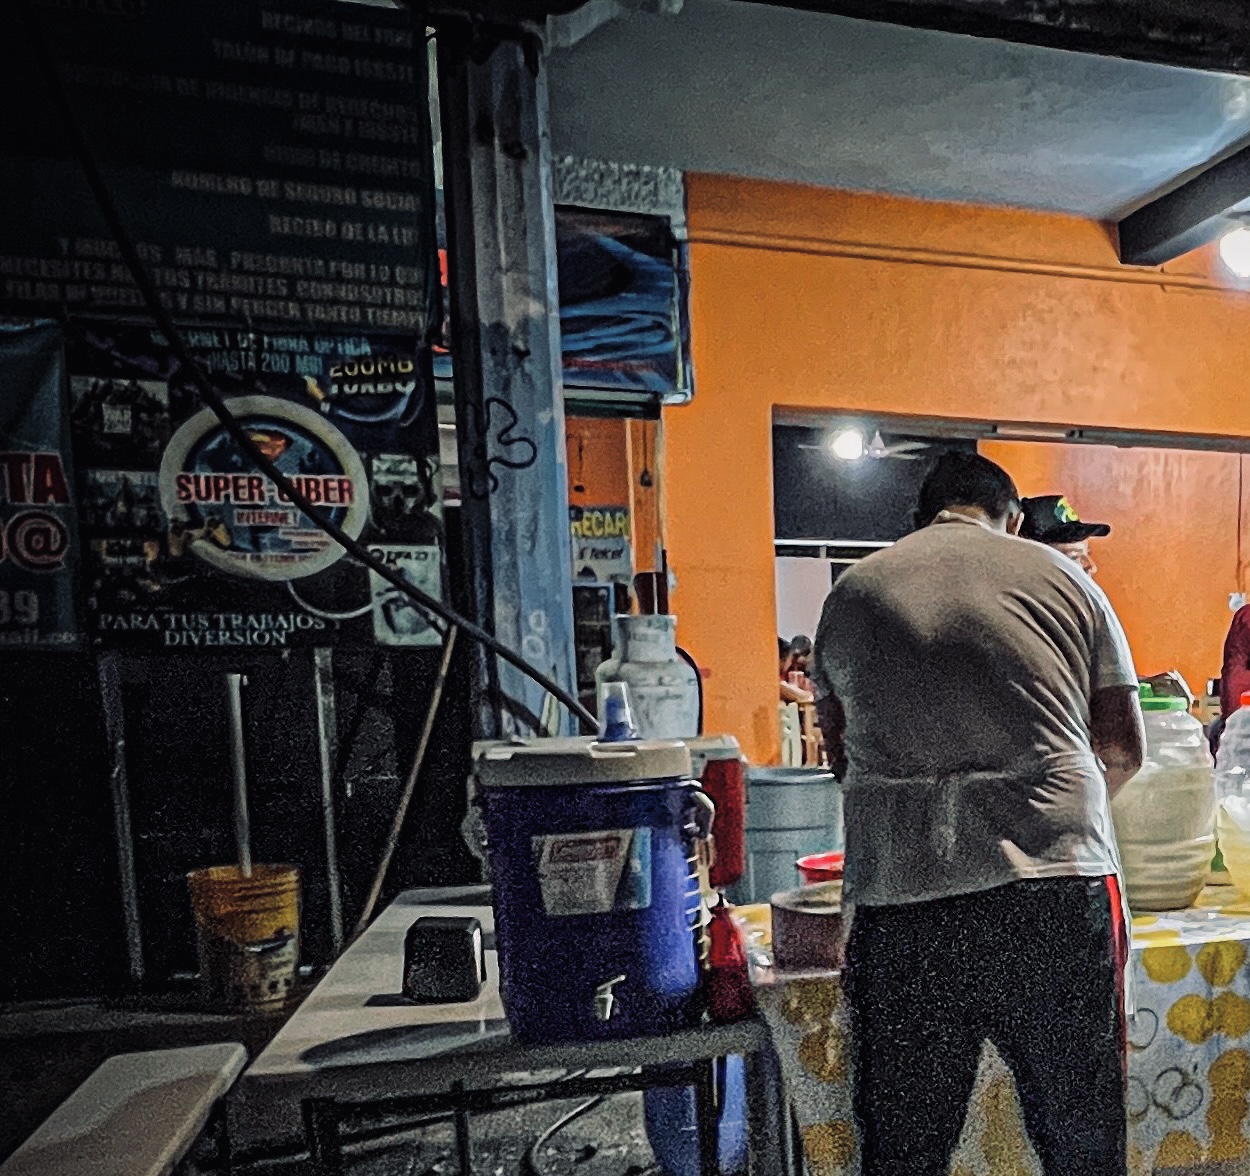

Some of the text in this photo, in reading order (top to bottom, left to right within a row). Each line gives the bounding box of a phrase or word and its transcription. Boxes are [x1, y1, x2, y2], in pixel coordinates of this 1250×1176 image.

[256, 178, 280, 198] DE
[341, 220, 364, 242] DE
[367, 223, 388, 243] LA
[261, 352, 290, 373] 200
[175, 474, 265, 502] SUPER
[98, 613, 161, 631] PARA
[163, 613, 210, 631] TUS
[213, 613, 326, 633] TRABAJOS
